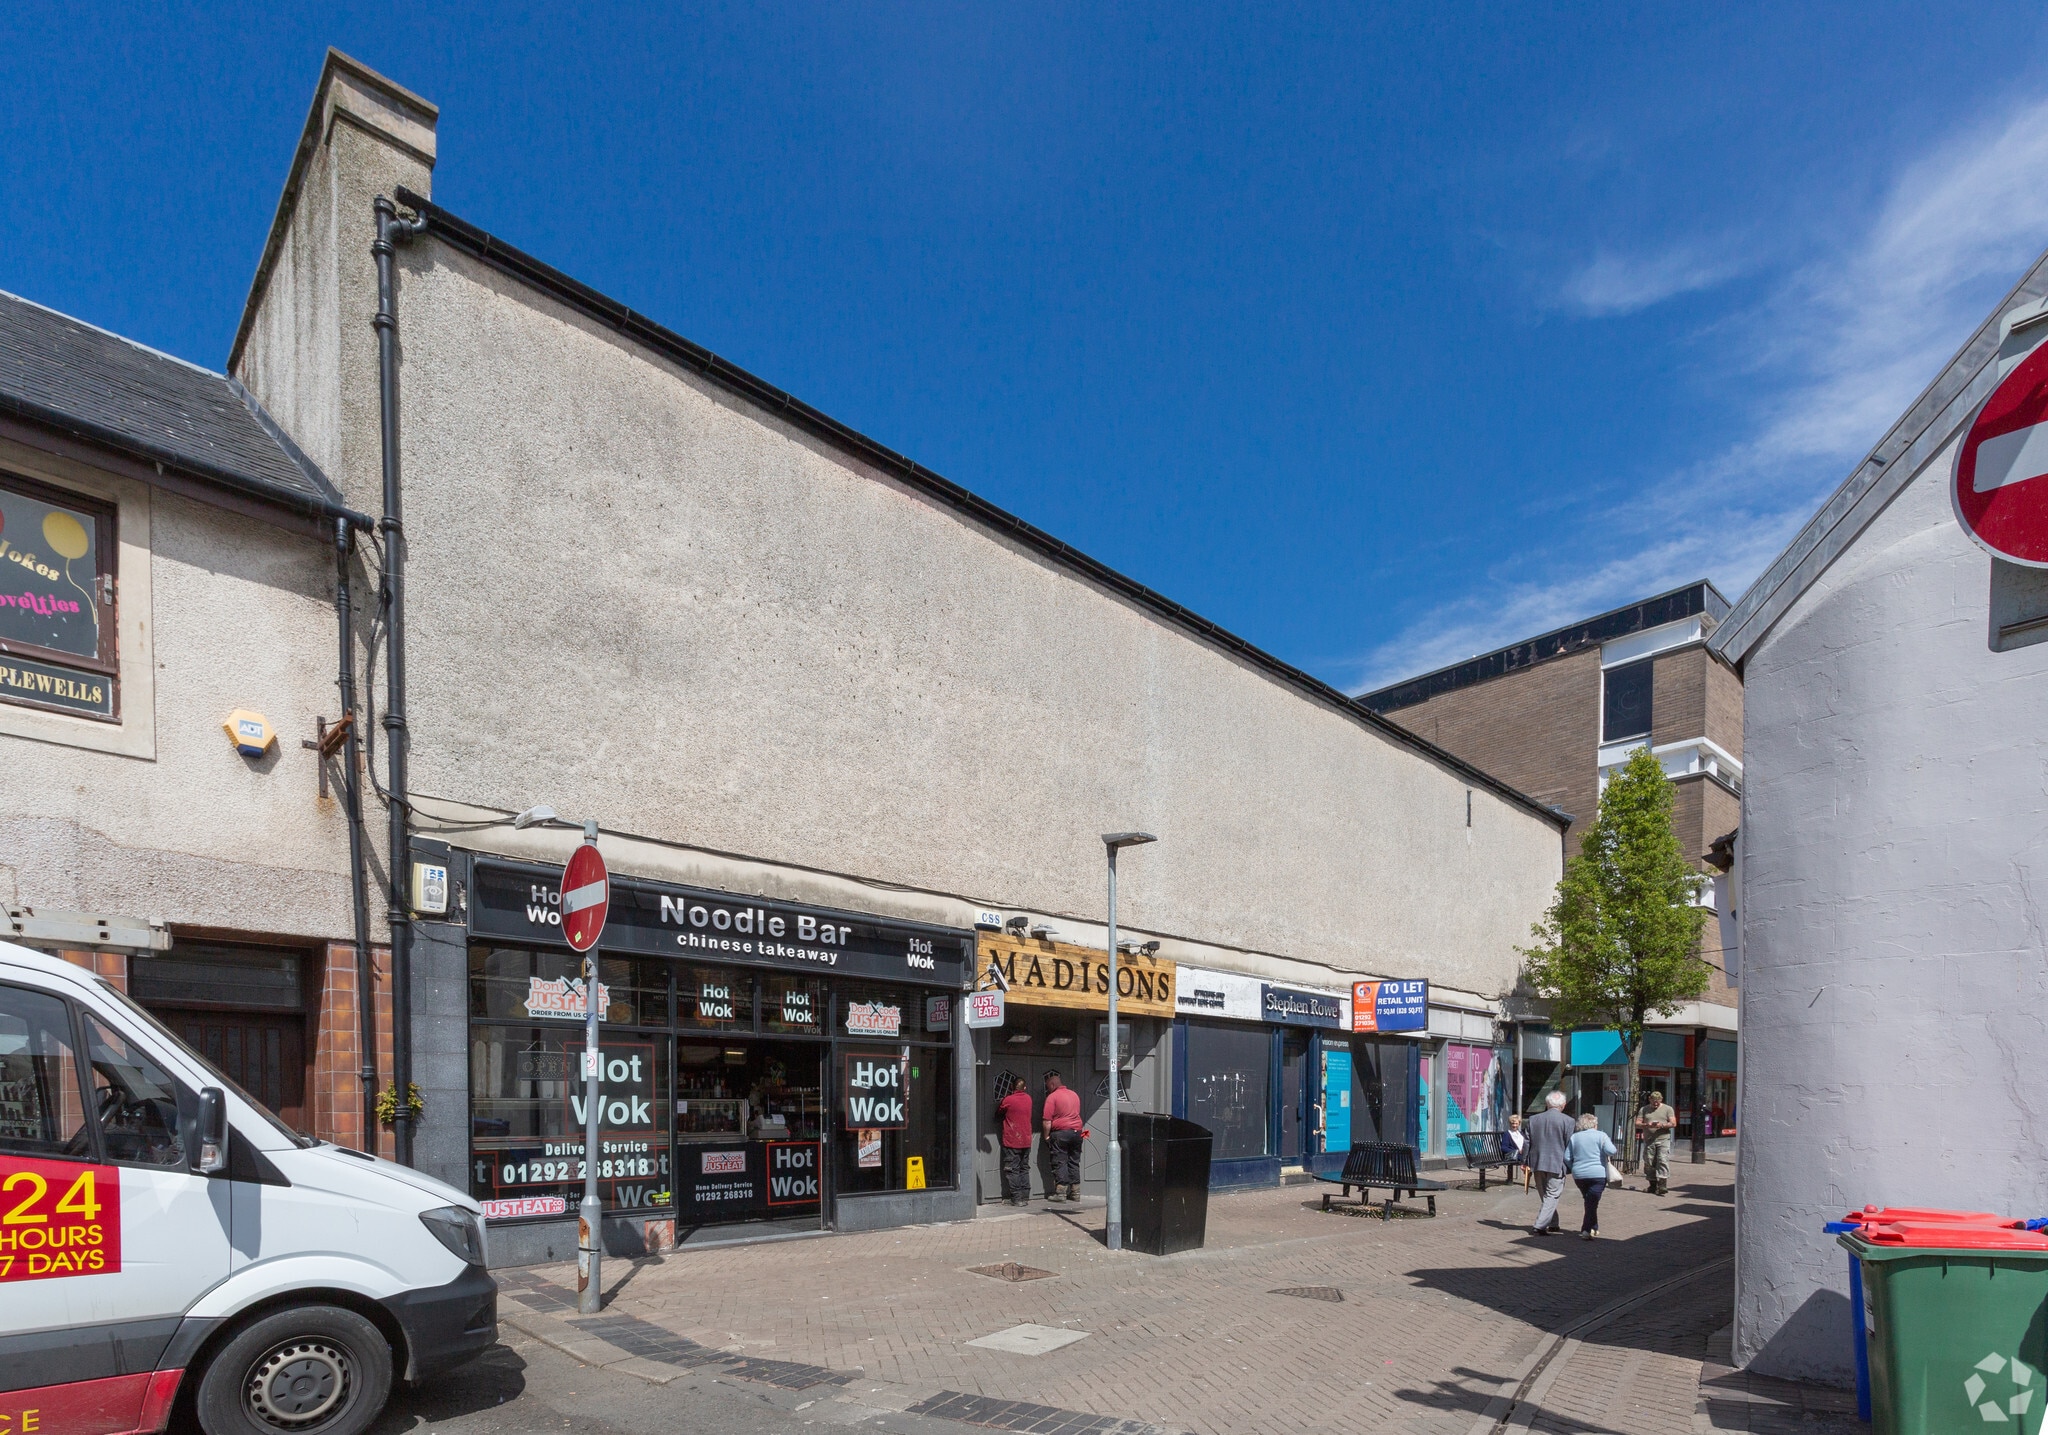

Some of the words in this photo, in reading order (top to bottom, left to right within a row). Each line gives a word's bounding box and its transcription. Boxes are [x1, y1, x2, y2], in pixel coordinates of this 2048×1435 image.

[239, 722, 263, 737] ADT
[531, 885, 561, 905] Ho
[526, 904, 561, 925] Wo
[660, 895, 785, 937] Noodle
[797, 915, 851, 945] Bar
[677, 933, 752, 953] chinese
[757, 941, 838, 965] takeaway
[910, 938, 932, 954] Hot
[907, 953, 934, 969] Wok
[989, 949, 1169, 1001] MADISONS
[533, 978, 565, 991] Don't
[577, 984, 607, 995] ck
[703, 983, 730, 999] Hot
[1384, 983, 1399, 994] TO
[1403, 982, 1423, 994] LET
[529, 992, 573, 1010] JUST
[574, 994, 608, 1012] ET
[786, 991, 810, 1006] Hot
[973, 996, 994, 1008] JUST
[1266, 993, 1309, 1016] Stephen
[1310, 999, 1338, 1018] Rowe
[1378, 997, 1403, 1005] RETAIL
[1405, 996, 1423, 1004] UNIT
[699, 1002, 733, 1018] Wok
[783, 1008, 812, 1023] Wok
[879, 1005, 898, 1015] cook
[978, 1007, 993, 1017] EAT
[849, 1015, 877, 1028] JUST
[879, 1017, 900, 1030] EAT
[522, 1061, 571, 1073] OPEN
[580, 1052, 642, 1082] Hot
[856, 1062, 898, 1088] Hot
[570, 1095, 651, 1125] Wok
[850, 1097, 904, 1122] Wok
[545, 1143, 585, 1156] Delive
[603, 1141, 648, 1154] Service
[705, 1162, 726, 1171] JUST
[727, 1161, 744, 1170] EAT
[776, 1148, 813, 1168] Hot
[503, 1160, 569, 1184] 01292
[771, 1175, 818, 1197] Wok
[2, 1170, 102, 1225] 24
[695, 1191, 721, 1201] 01292
[724, 1189, 753, 1199] 268318
[481, 1201, 522, 1217] JUST
[522, 1199, 553, 1214] EAT
[0, 1224, 103, 1251] HOURS
[0, 1255, 15, 1277] 7
[29, 1249, 105, 1274] DAYS
